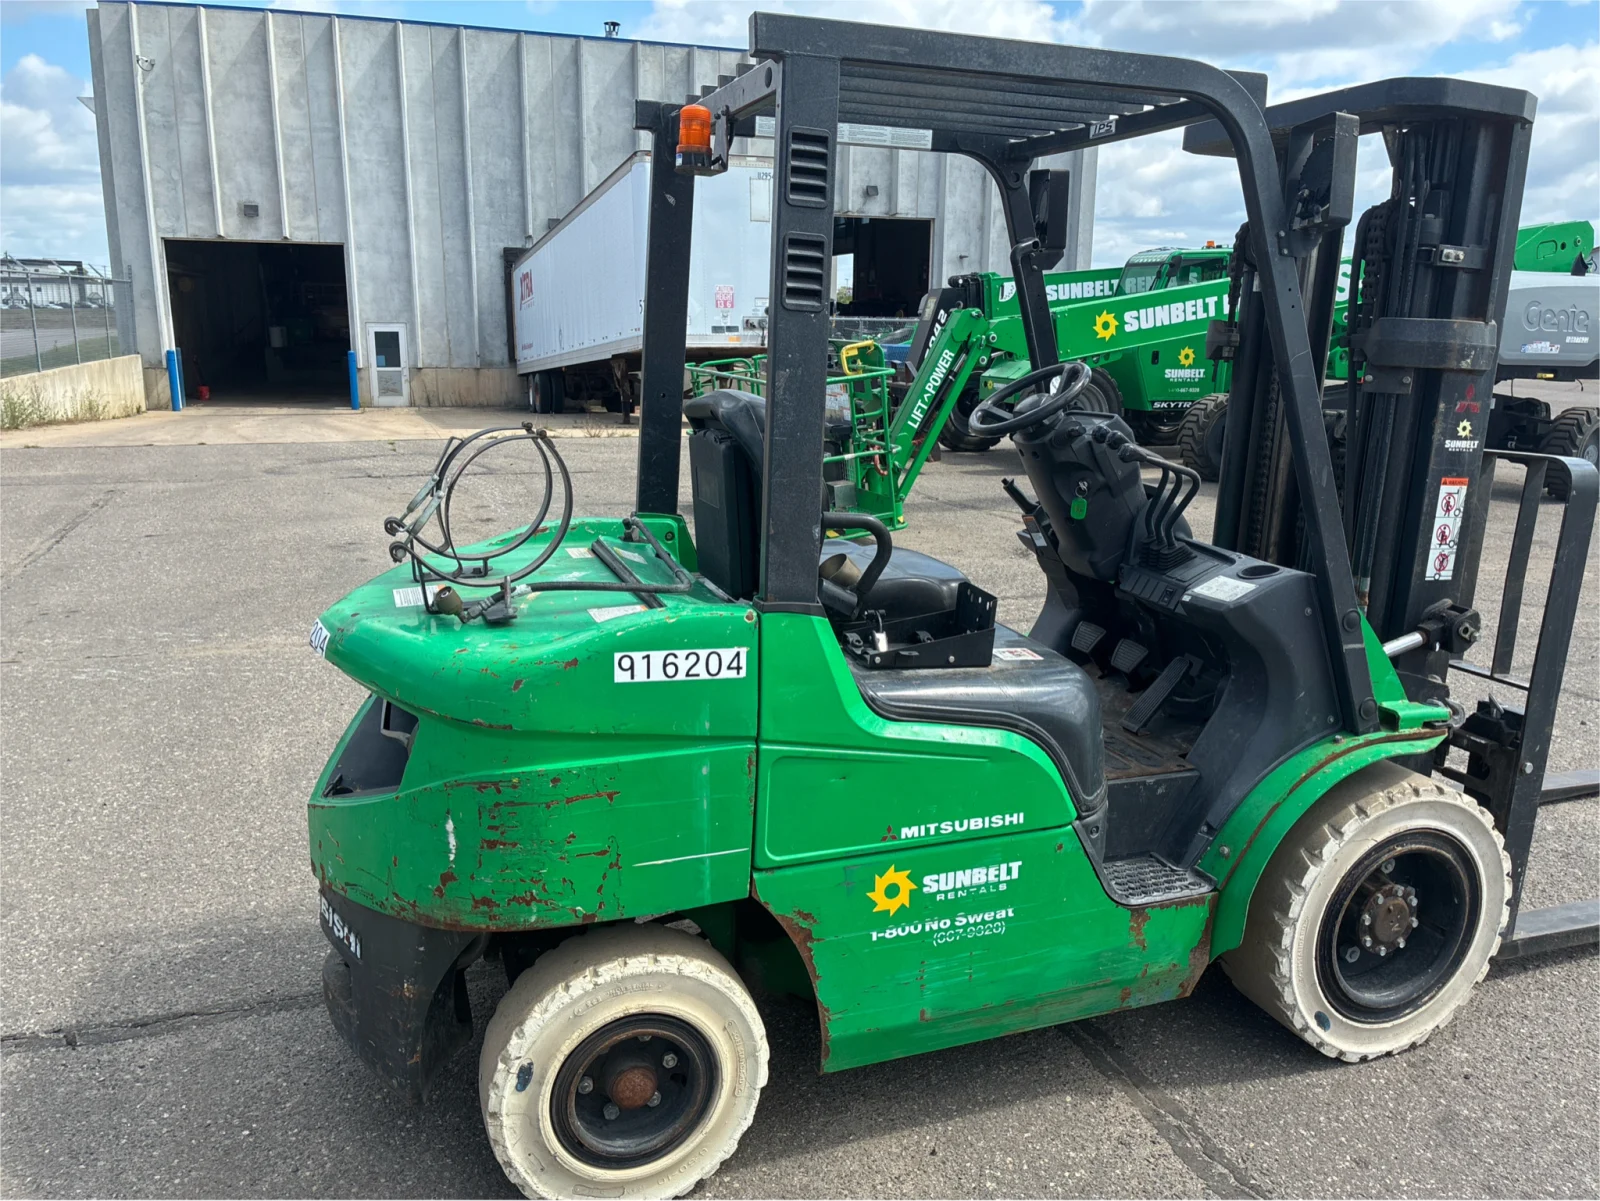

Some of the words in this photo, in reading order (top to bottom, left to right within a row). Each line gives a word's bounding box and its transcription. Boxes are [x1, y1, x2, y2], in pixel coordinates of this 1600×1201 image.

[1123, 296, 1218, 333] SUNBELT
[1523, 300, 1590, 332] Genie
[1164, 368, 1206, 378] SUNBELT
[907, 399, 928, 429] LIFT
[925, 349, 955, 395] POWER
[1444, 439, 1479, 449] SUNBELT
[616, 650, 744, 681] 916204
[901, 812, 1024, 839] MITSUBISHI
[922, 861, 1022, 894] SUNBELT
[925, 916, 950, 932] No
[954, 907, 1014, 926] Sweat
